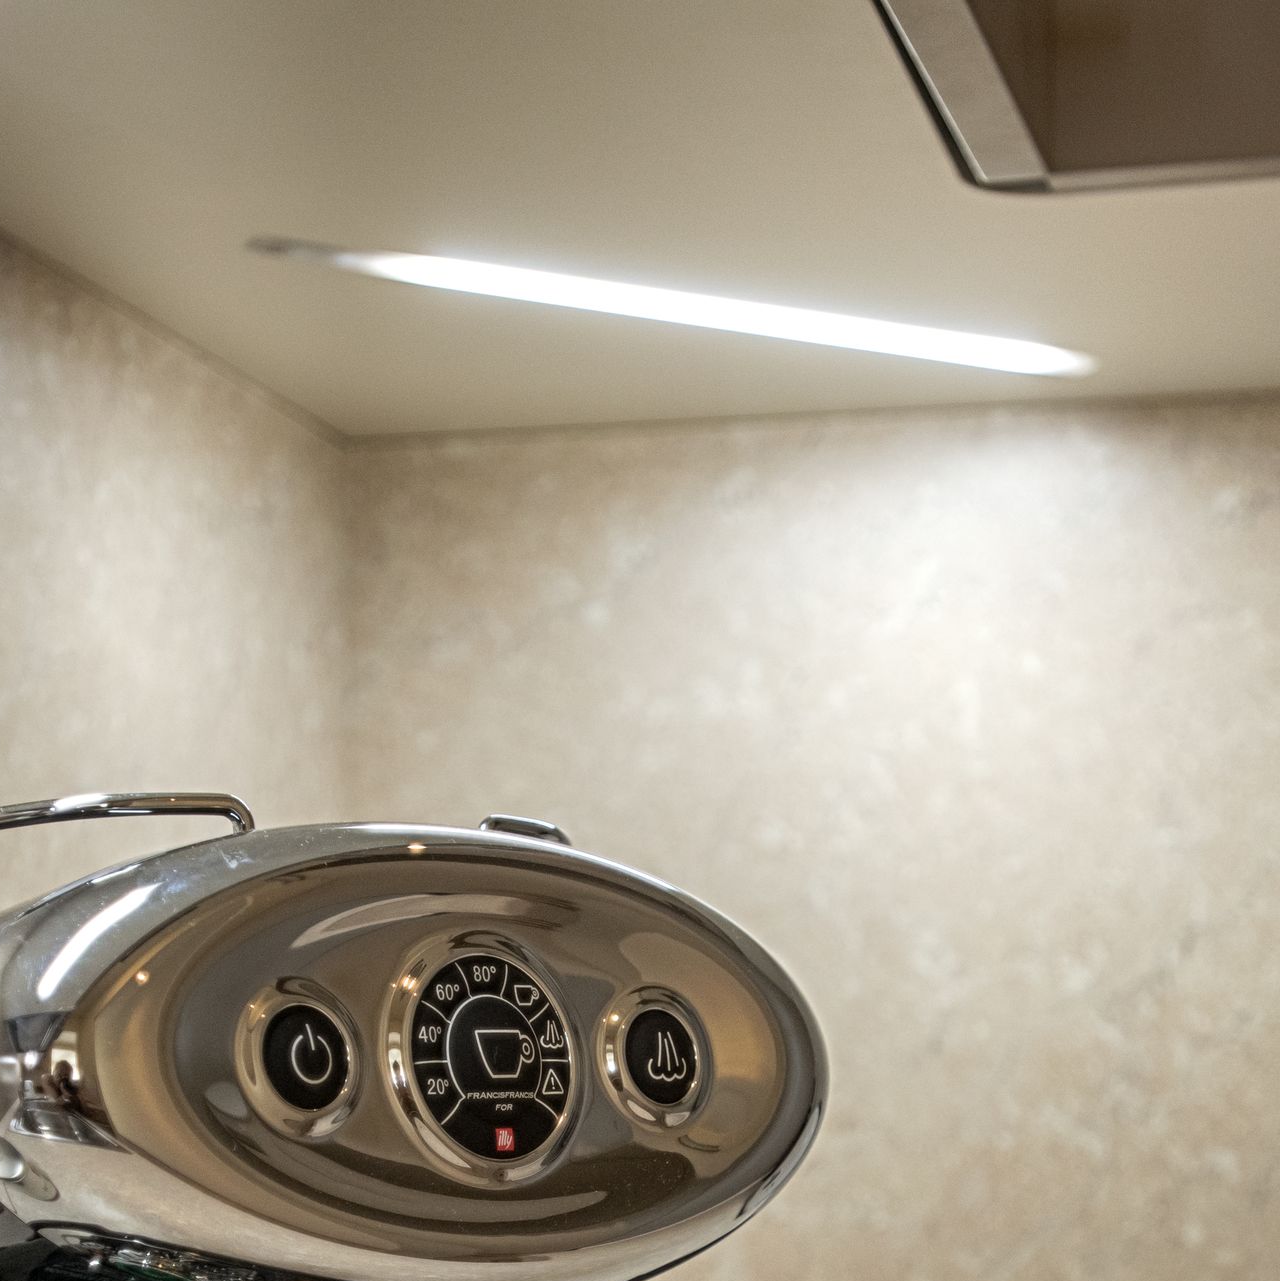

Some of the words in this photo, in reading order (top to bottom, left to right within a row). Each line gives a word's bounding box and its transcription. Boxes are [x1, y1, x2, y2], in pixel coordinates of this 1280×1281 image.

[473, 965, 497, 983] 80°
[436, 984, 460, 1001] 60°
[418, 1026, 442, 1043] 40°
[427, 1078, 449, 1095] 20°
[495, 1103, 513, 1111] FOR
[498, 1130, 513, 1150] illy
